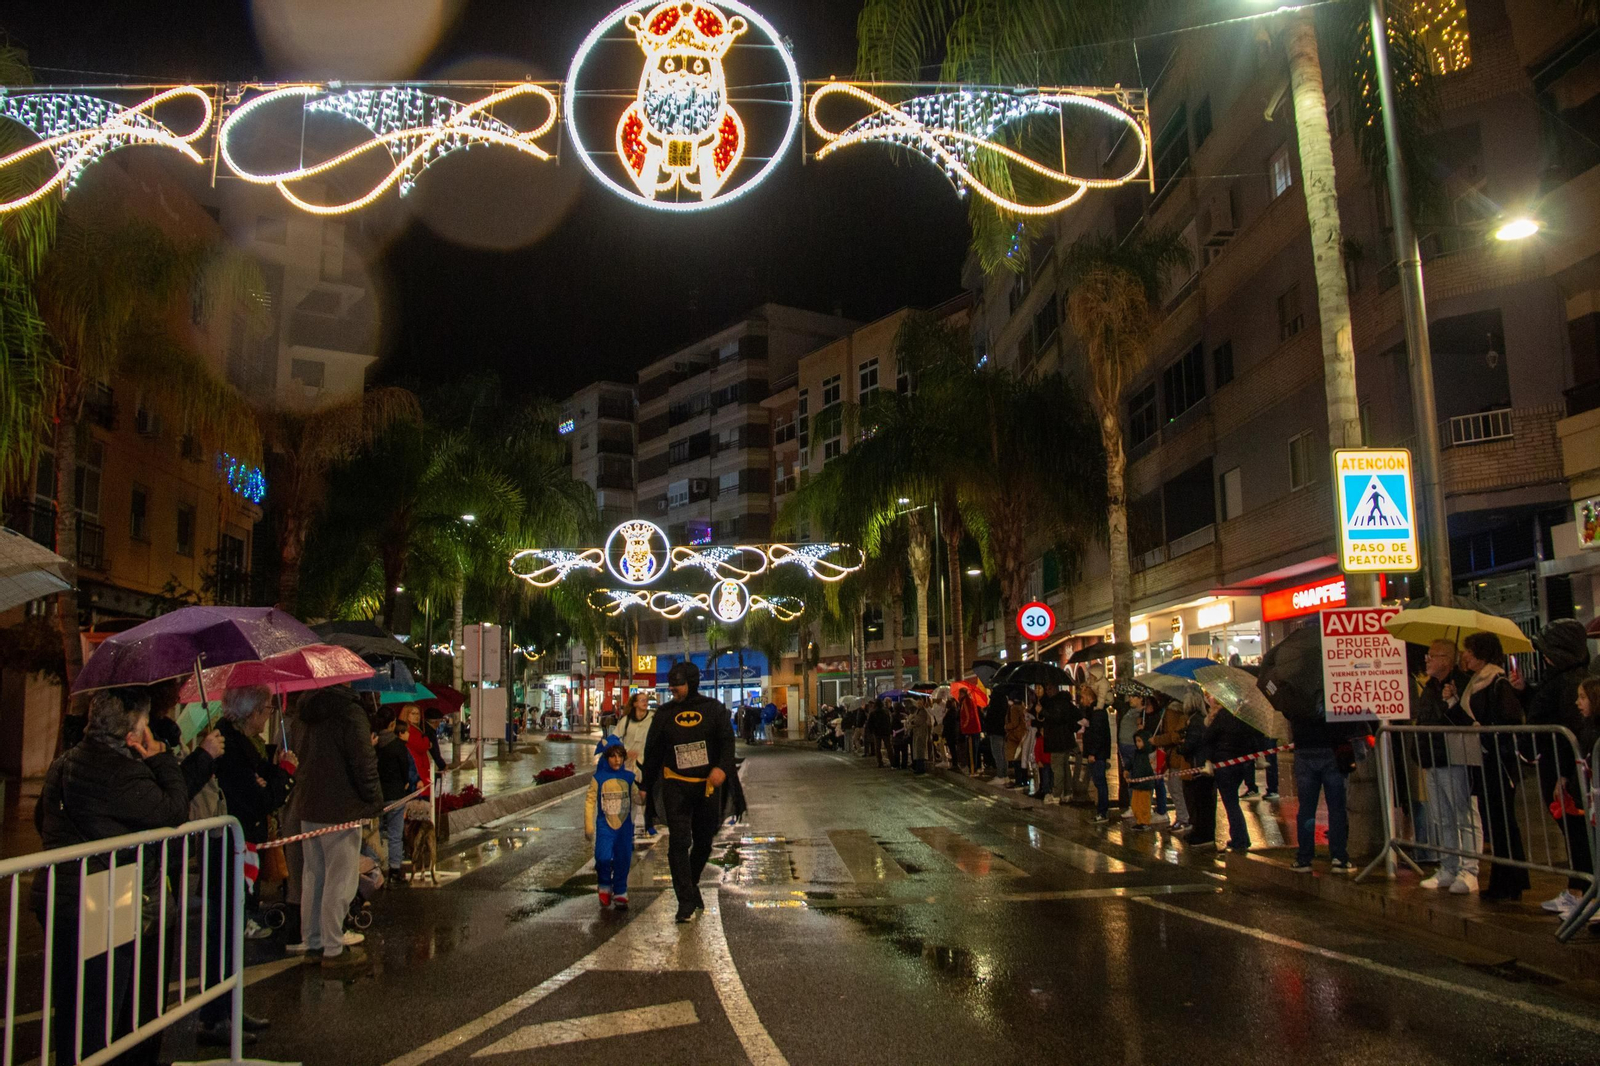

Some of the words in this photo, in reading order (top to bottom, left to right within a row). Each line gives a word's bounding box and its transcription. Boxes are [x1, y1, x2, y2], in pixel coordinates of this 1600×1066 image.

[1342, 455, 1405, 470] ATENCIÓN
[1352, 543, 1386, 553] PASO
[1392, 542, 1408, 552] DE
[1348, 554, 1413, 565] PEATONES
[1026, 615, 1047, 627] 30
[1336, 636, 1391, 648] PRUEBA
[1327, 647, 1401, 660] DEPORTIVA
[881, 657, 906, 668] CHIO
[1332, 678, 1400, 692] TRÁFICO
[1330, 691, 1404, 704] CORTADO
[1333, 704, 1362, 716] 17:00
[1365, 707, 1372, 715] A
[1375, 703, 1404, 714] 21:00
